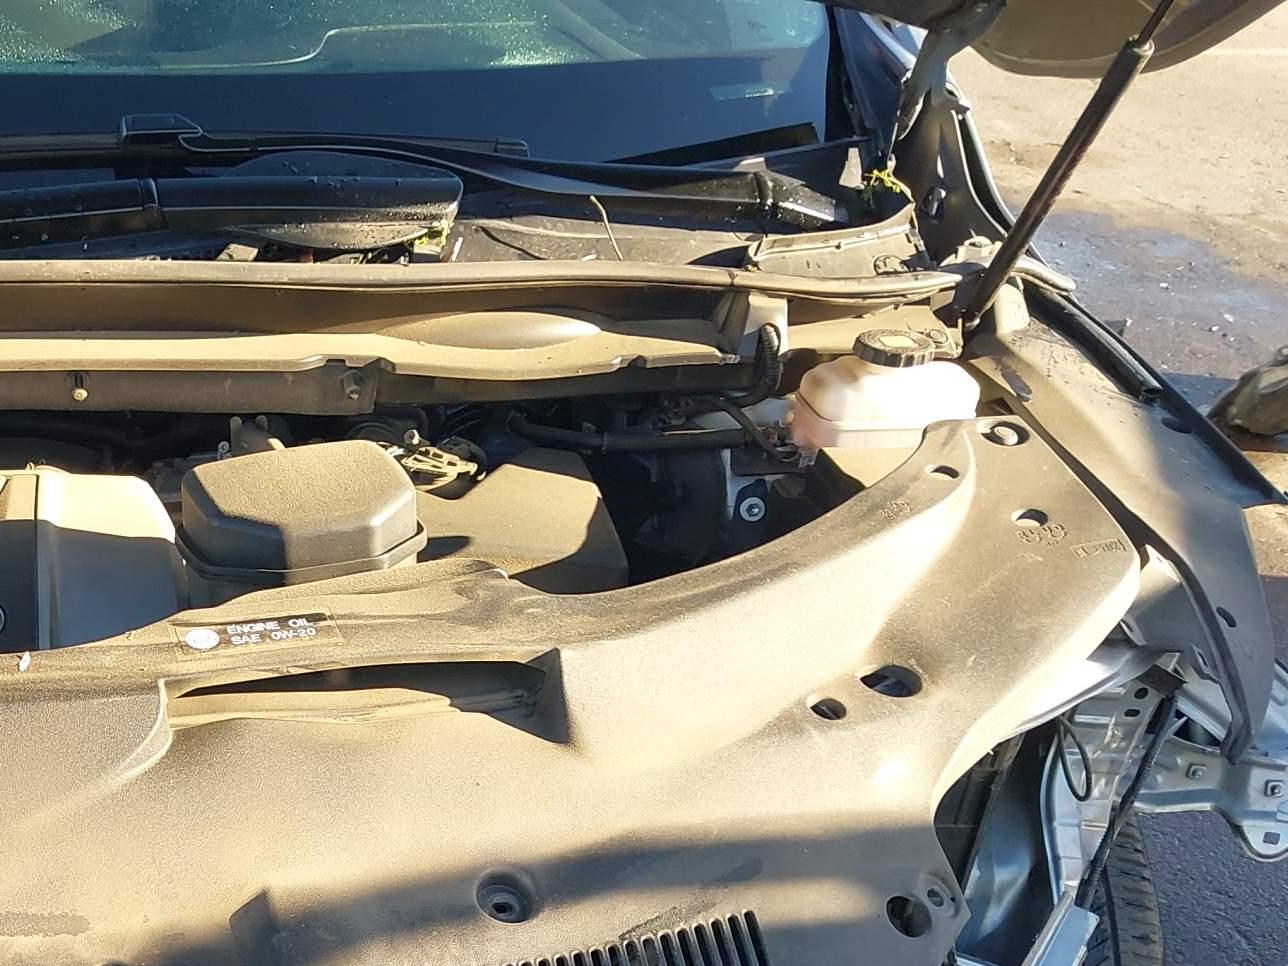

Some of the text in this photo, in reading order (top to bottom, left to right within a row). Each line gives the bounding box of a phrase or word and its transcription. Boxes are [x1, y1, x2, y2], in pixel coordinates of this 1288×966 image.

[226, 617, 314, 635] ENGINE OIL
[230, 627, 317, 645] SAE 0W-20
